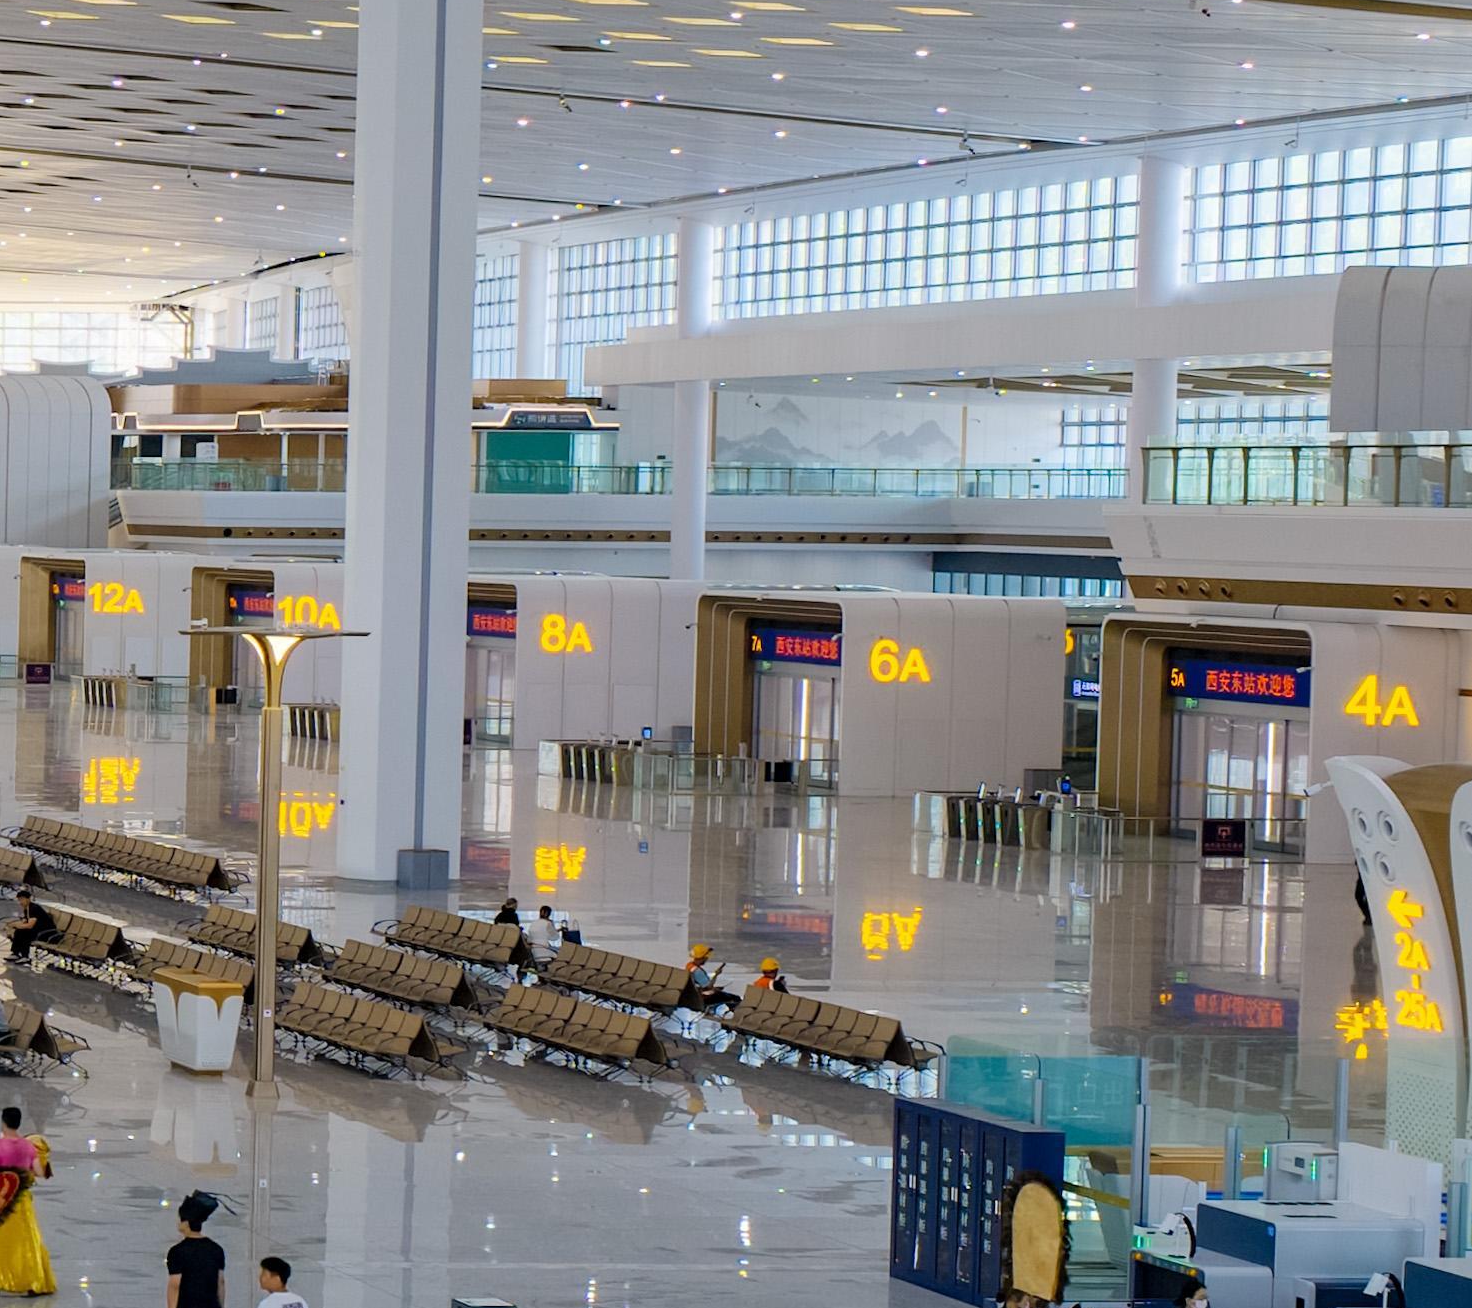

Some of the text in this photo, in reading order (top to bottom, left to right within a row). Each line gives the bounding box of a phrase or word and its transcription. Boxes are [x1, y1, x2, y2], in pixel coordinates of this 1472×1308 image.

[88, 582, 144, 614] 12A
[278, 595, 342, 631] 10A
[540, 613, 593, 653] 8A
[751, 635, 762, 652] 7A
[869, 639, 931, 684] 6A
[1170, 667, 1295, 698] 5A 西安东站欢迎您
[1344, 674, 1420, 727] 4A
[1394, 930, 1431, 971] 2A
[1395, 990, 1444, 1033] 25A
